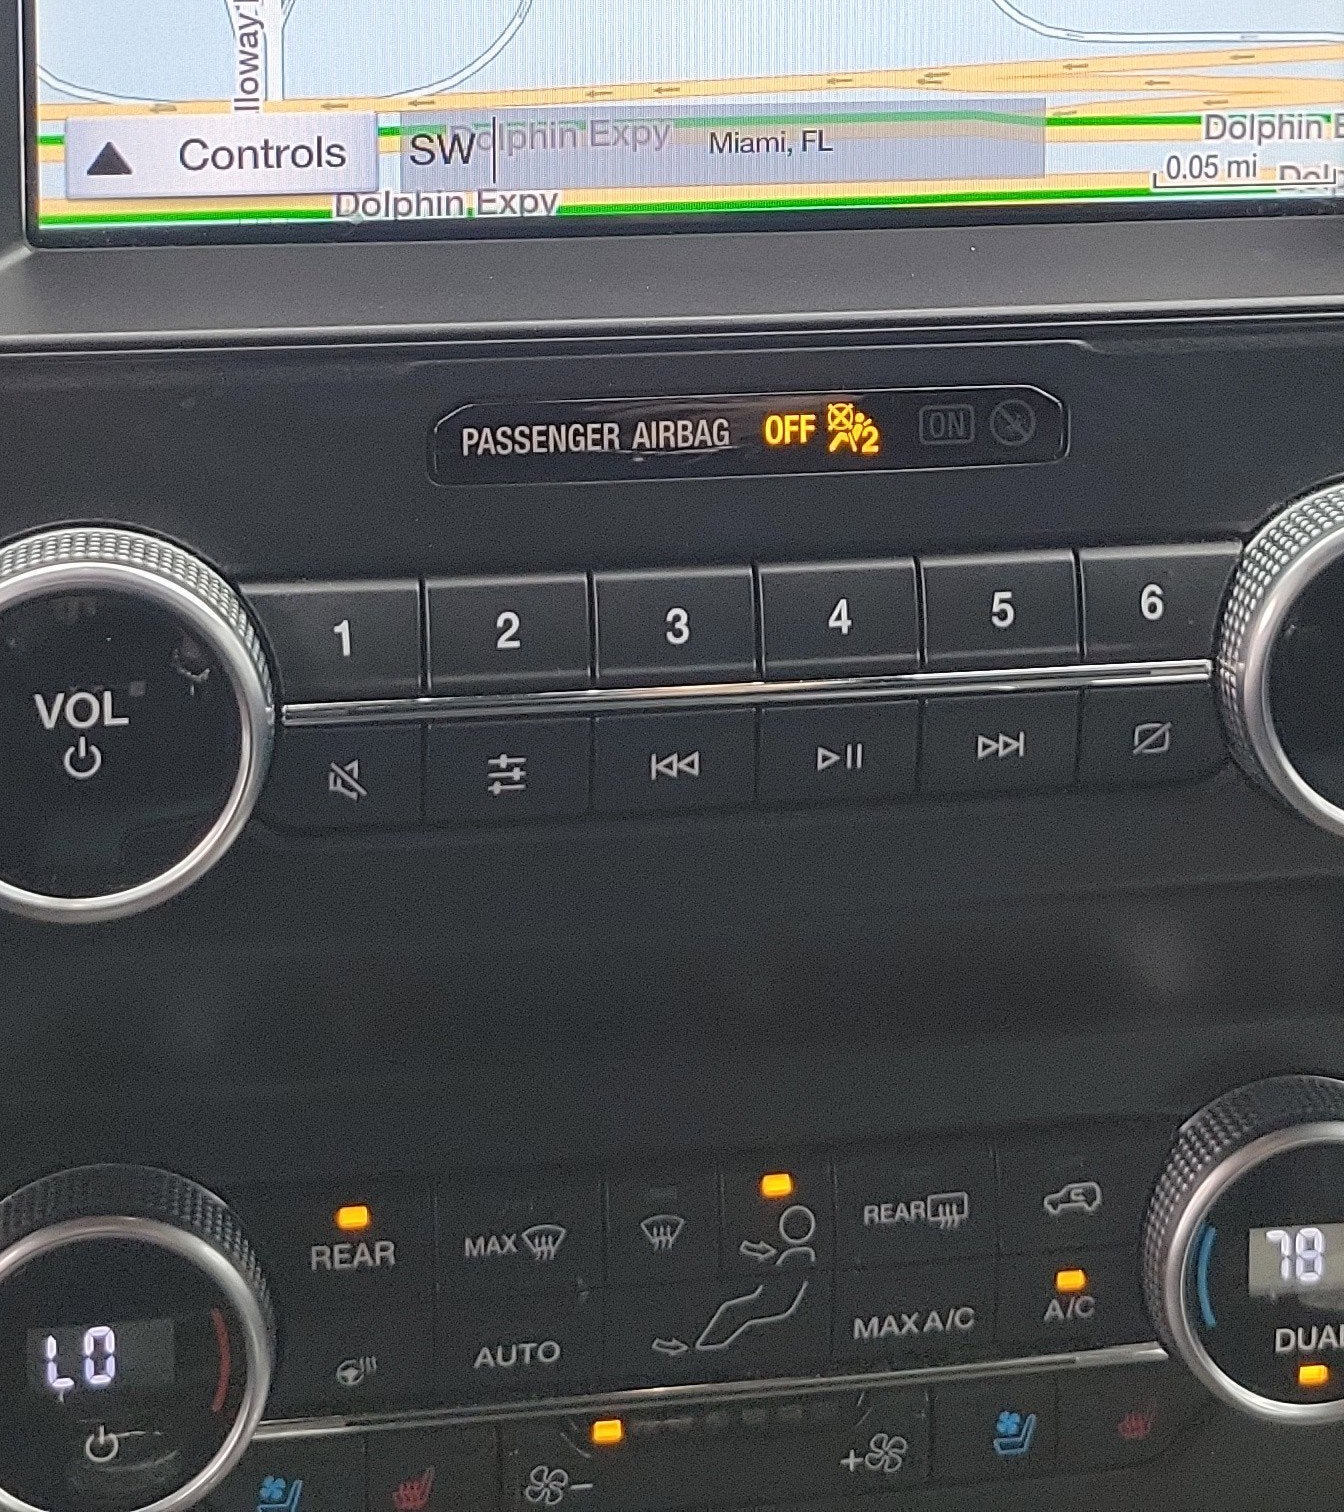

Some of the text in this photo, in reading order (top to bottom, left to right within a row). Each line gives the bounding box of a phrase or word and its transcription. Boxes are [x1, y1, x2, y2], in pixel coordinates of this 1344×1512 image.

[589, 117, 672, 152] Expy
[709, 129, 834, 157] Miami, FL
[1205, 113, 1323, 146] Dolphin
[179, 135, 347, 171] Controls
[409, 133, 476, 166] SW
[1166, 153, 1258, 180] 0.05 mi
[335, 190, 465, 219] Dolphin
[462, 414, 817, 456] PASSENGER AIRBAG OFF
[928, 411, 966, 439] ON
[828, 598, 852, 635] 4
[991, 591, 1015, 628] 5
[1140, 584, 1164, 621] 6
[333, 619, 351, 657] 1
[496, 611, 521, 650] 2
[666, 607, 690, 645] 3
[34, 690, 130, 730] VOL
[864, 1201, 927, 1226] REAR
[311, 1241, 396, 1271] REAR
[464, 1234, 518, 1258] MAX
[853, 1307, 975, 1340] MAX A/C
[1044, 1295, 1096, 1323] A/C
[473, 1341, 561, 1369] AUTO
